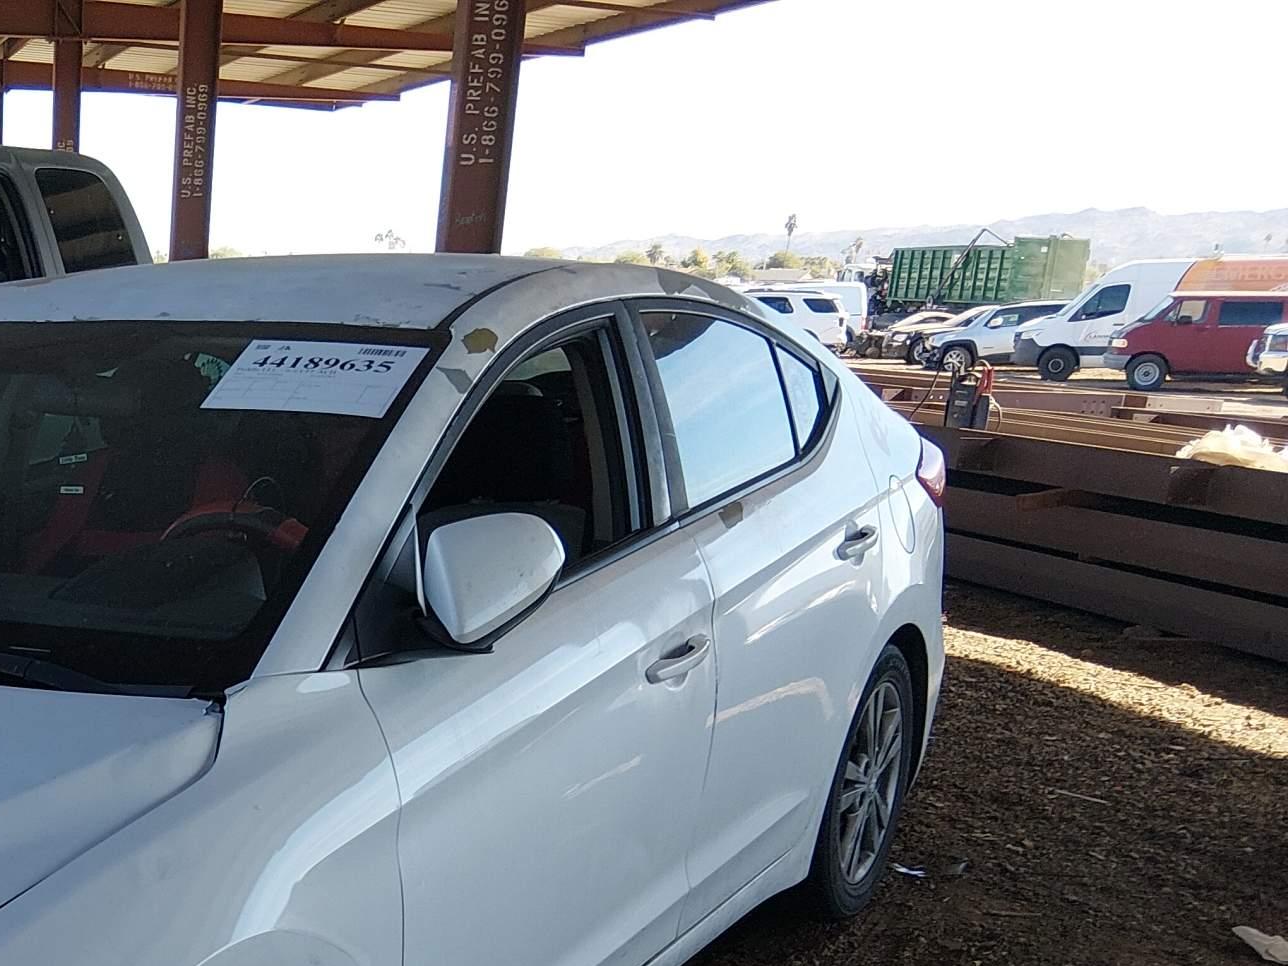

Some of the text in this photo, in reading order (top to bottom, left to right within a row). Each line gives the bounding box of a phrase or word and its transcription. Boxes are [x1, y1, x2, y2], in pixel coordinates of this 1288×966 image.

[464, 34, 488, 115] PREFAB
[181, 83, 198, 198] U.S. PREFAB INC.
[192, 84, 209, 198] 1-866-799-0969
[459, 127, 479, 166] U.S.
[253, 354, 396, 374] 44189635
